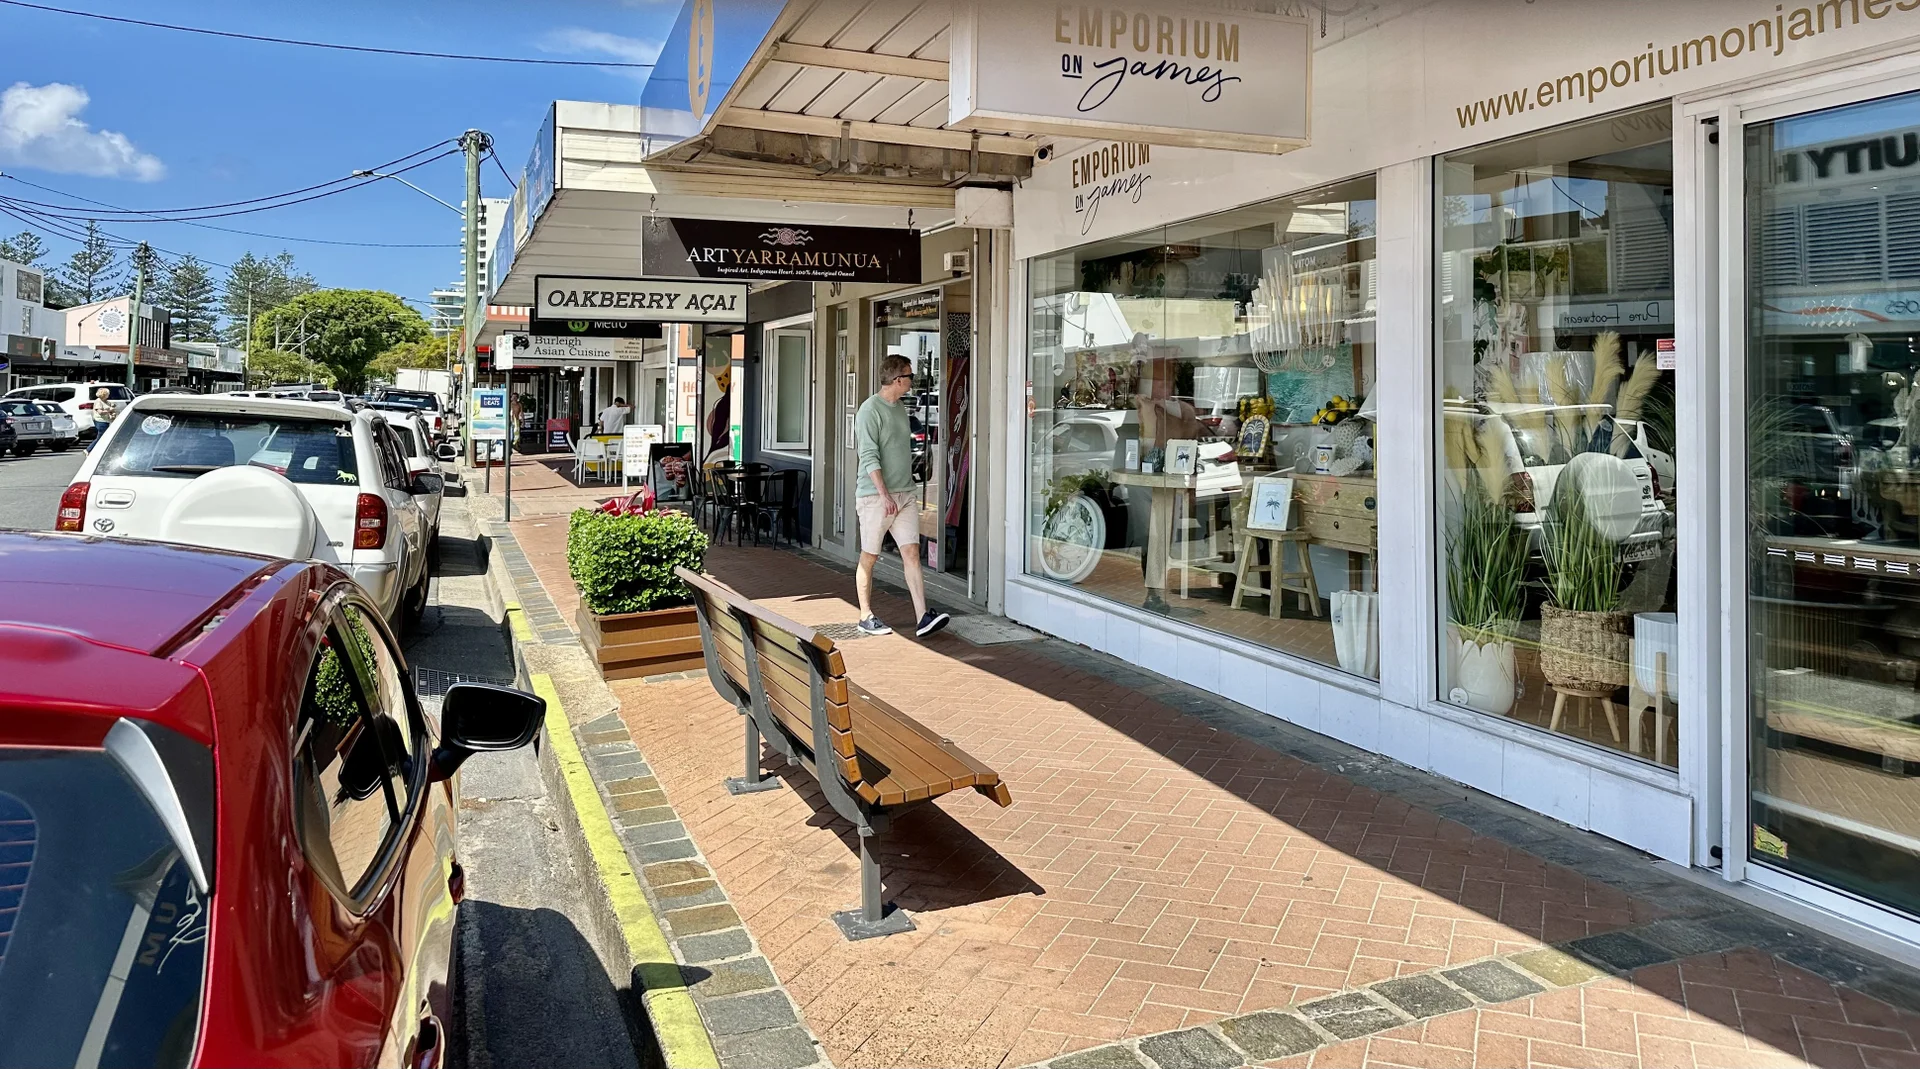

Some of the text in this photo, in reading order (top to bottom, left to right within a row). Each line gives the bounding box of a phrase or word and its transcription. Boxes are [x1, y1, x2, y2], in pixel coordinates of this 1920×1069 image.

[1055, 4, 1239, 62] EMPORIUM
[1062, 54, 1082, 78] ON
[1072, 141, 1150, 189] EMPORIUM
[1075, 194, 1084, 213] ON
[686, 247, 882, 269] ART YARRAMUNUA
[717, 266, 739, 275] Inspired
[750, 268, 777, 276] Indigenous
[811, 270, 837, 278] Aboriginal
[547, 289, 737, 315] OAKBERRY AÇAI
[534, 346, 610, 357] Asian Cuisine
[535, 335, 581, 347] Burleigh
